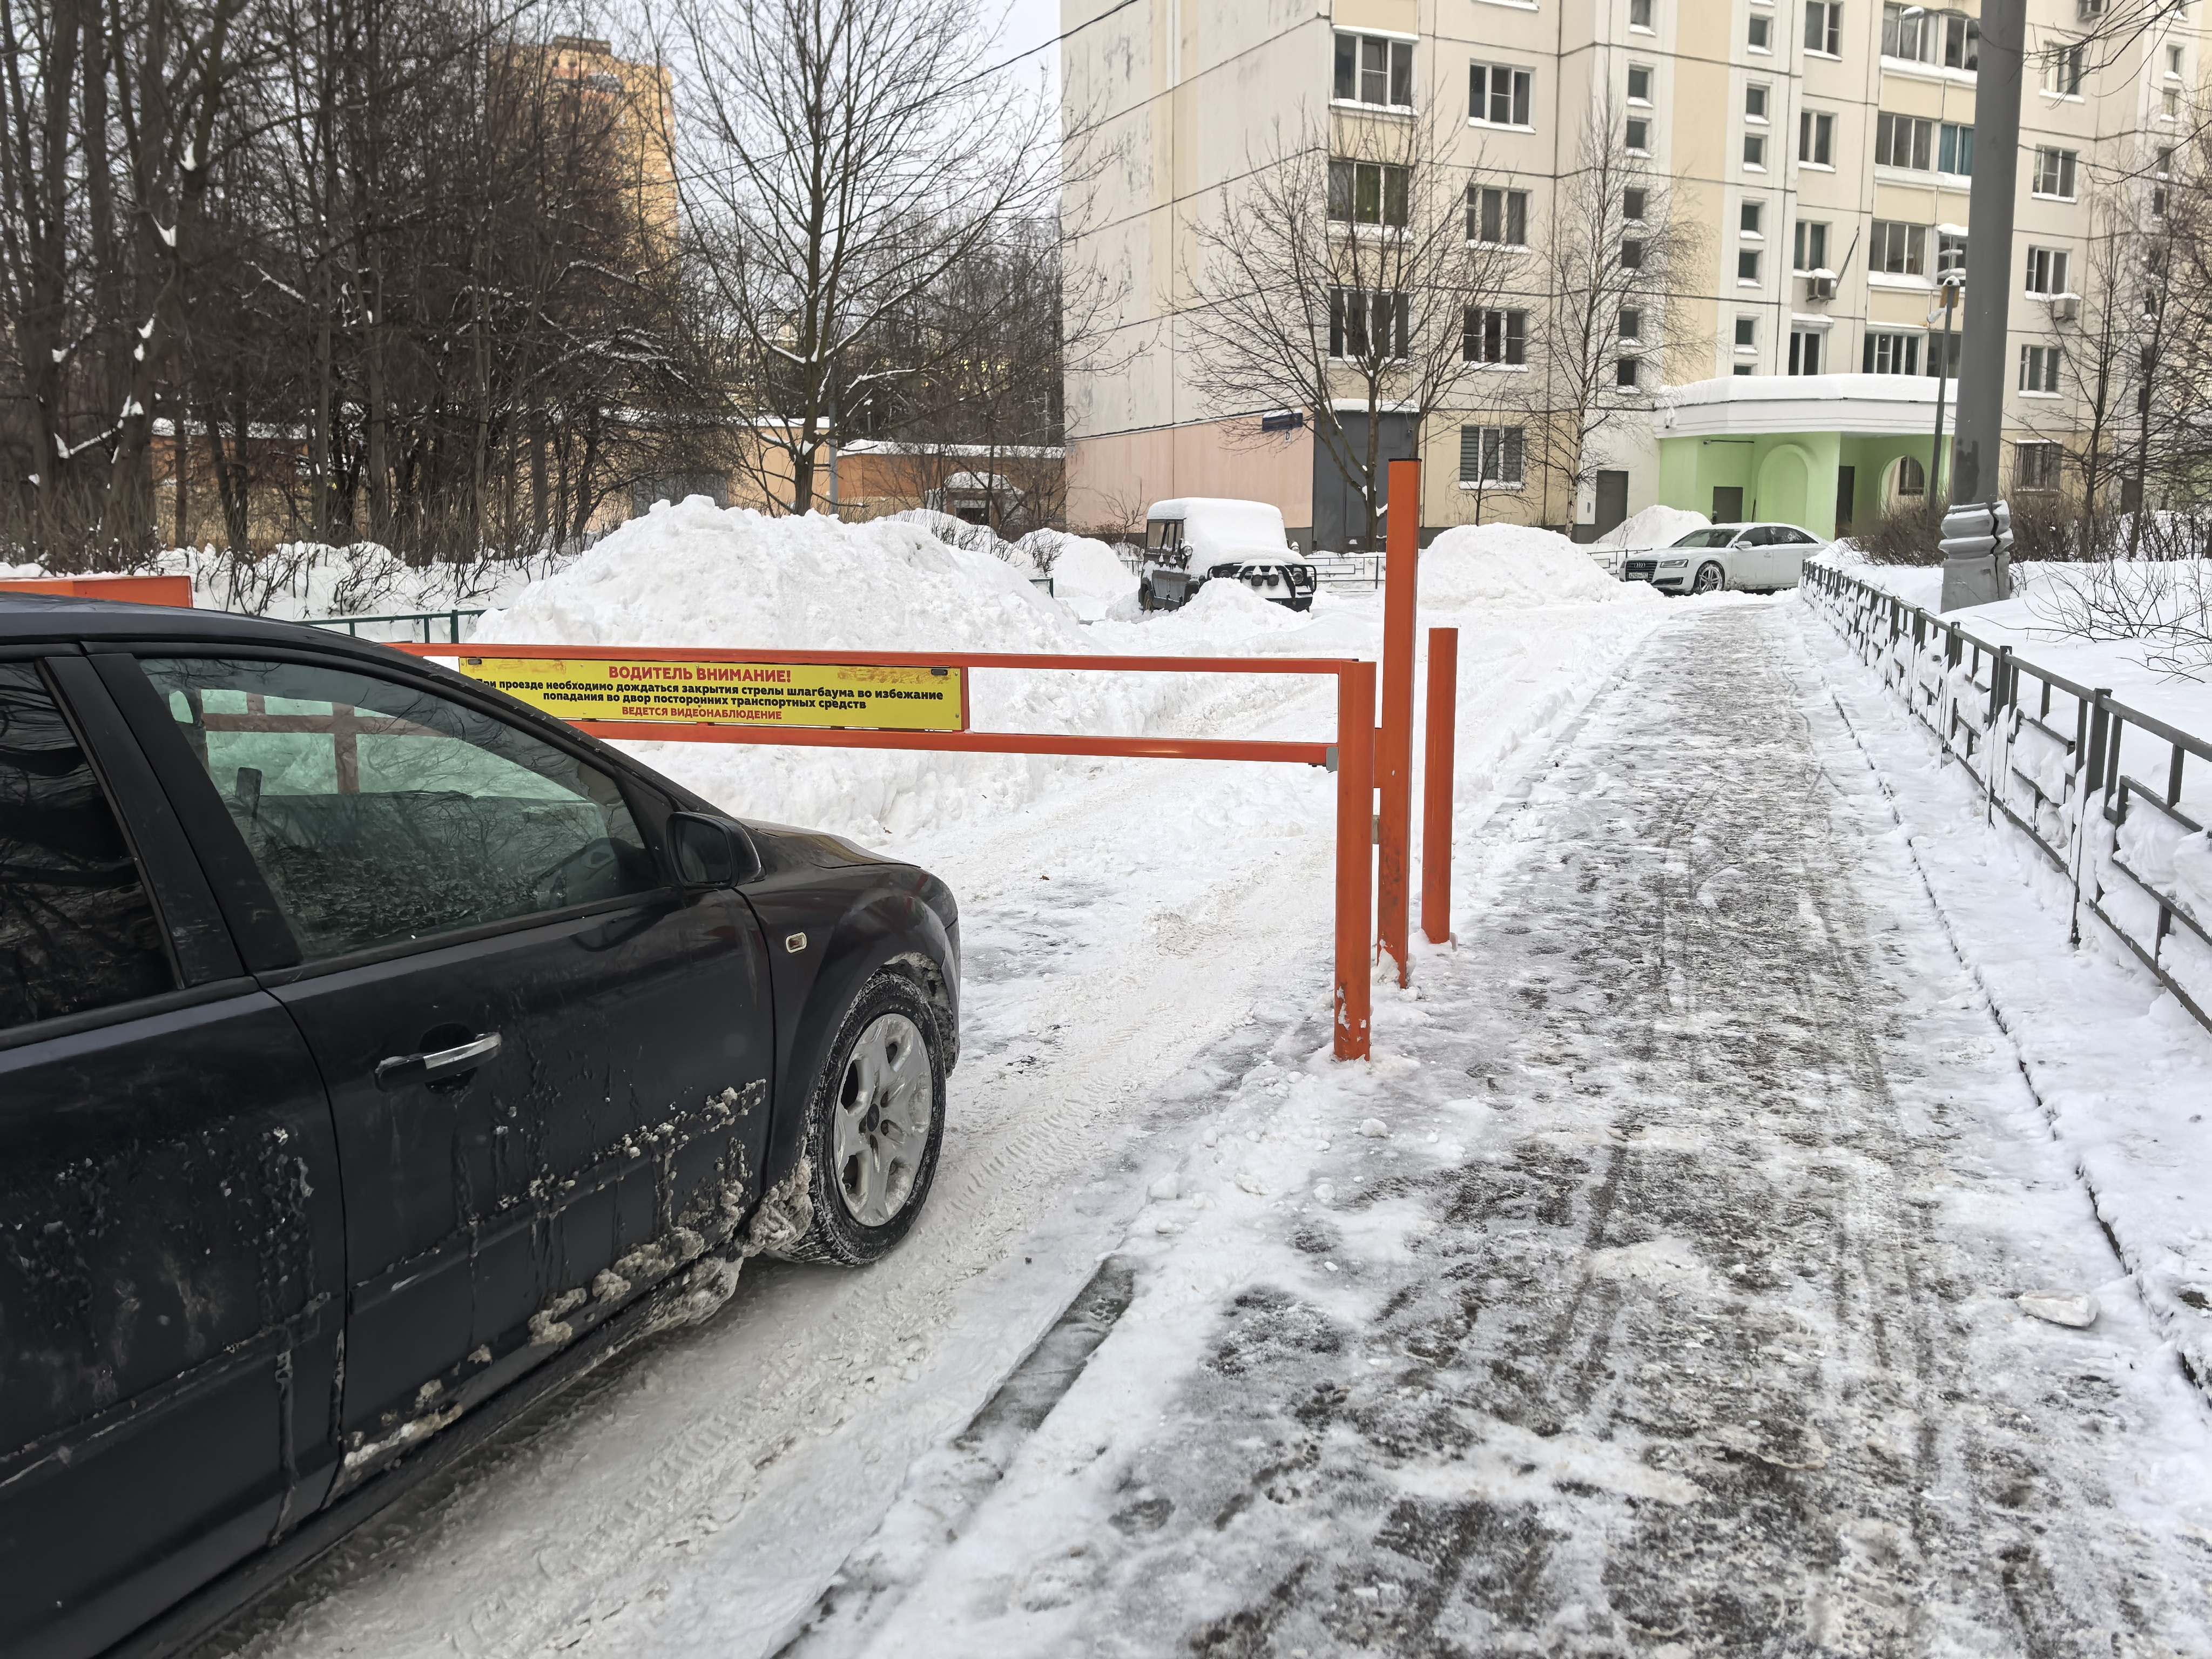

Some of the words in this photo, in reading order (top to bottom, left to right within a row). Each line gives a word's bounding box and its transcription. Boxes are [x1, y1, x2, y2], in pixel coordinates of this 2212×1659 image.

[609, 666, 693, 681] ВОДИТЕЛЬ
[696, 667, 791, 683] ВНИМАНИЕ!
[500, 681, 543, 691] проезде
[546, 680, 613, 692] необходимо
[616, 684, 679, 694] дождаться
[682, 685, 739, 696] закрытия
[741, 687, 784, 697] стрелы
[787, 687, 855, 699] шлагбаума
[858, 690, 872, 698] во
[875, 689, 943, 700] избежание
[543, 692, 604, 702] попадания
[606, 694, 620, 702] во
[623, 694, 651, 705] двор
[653, 696, 729, 706] посторонних
[731, 698, 816, 709] транспортных
[818, 699, 866, 711] средств
[622, 706, 668, 716] ВЕДЕТСЯ
[671, 707, 782, 720] ВИДЕОНАБЛЮДЕНИЕ
